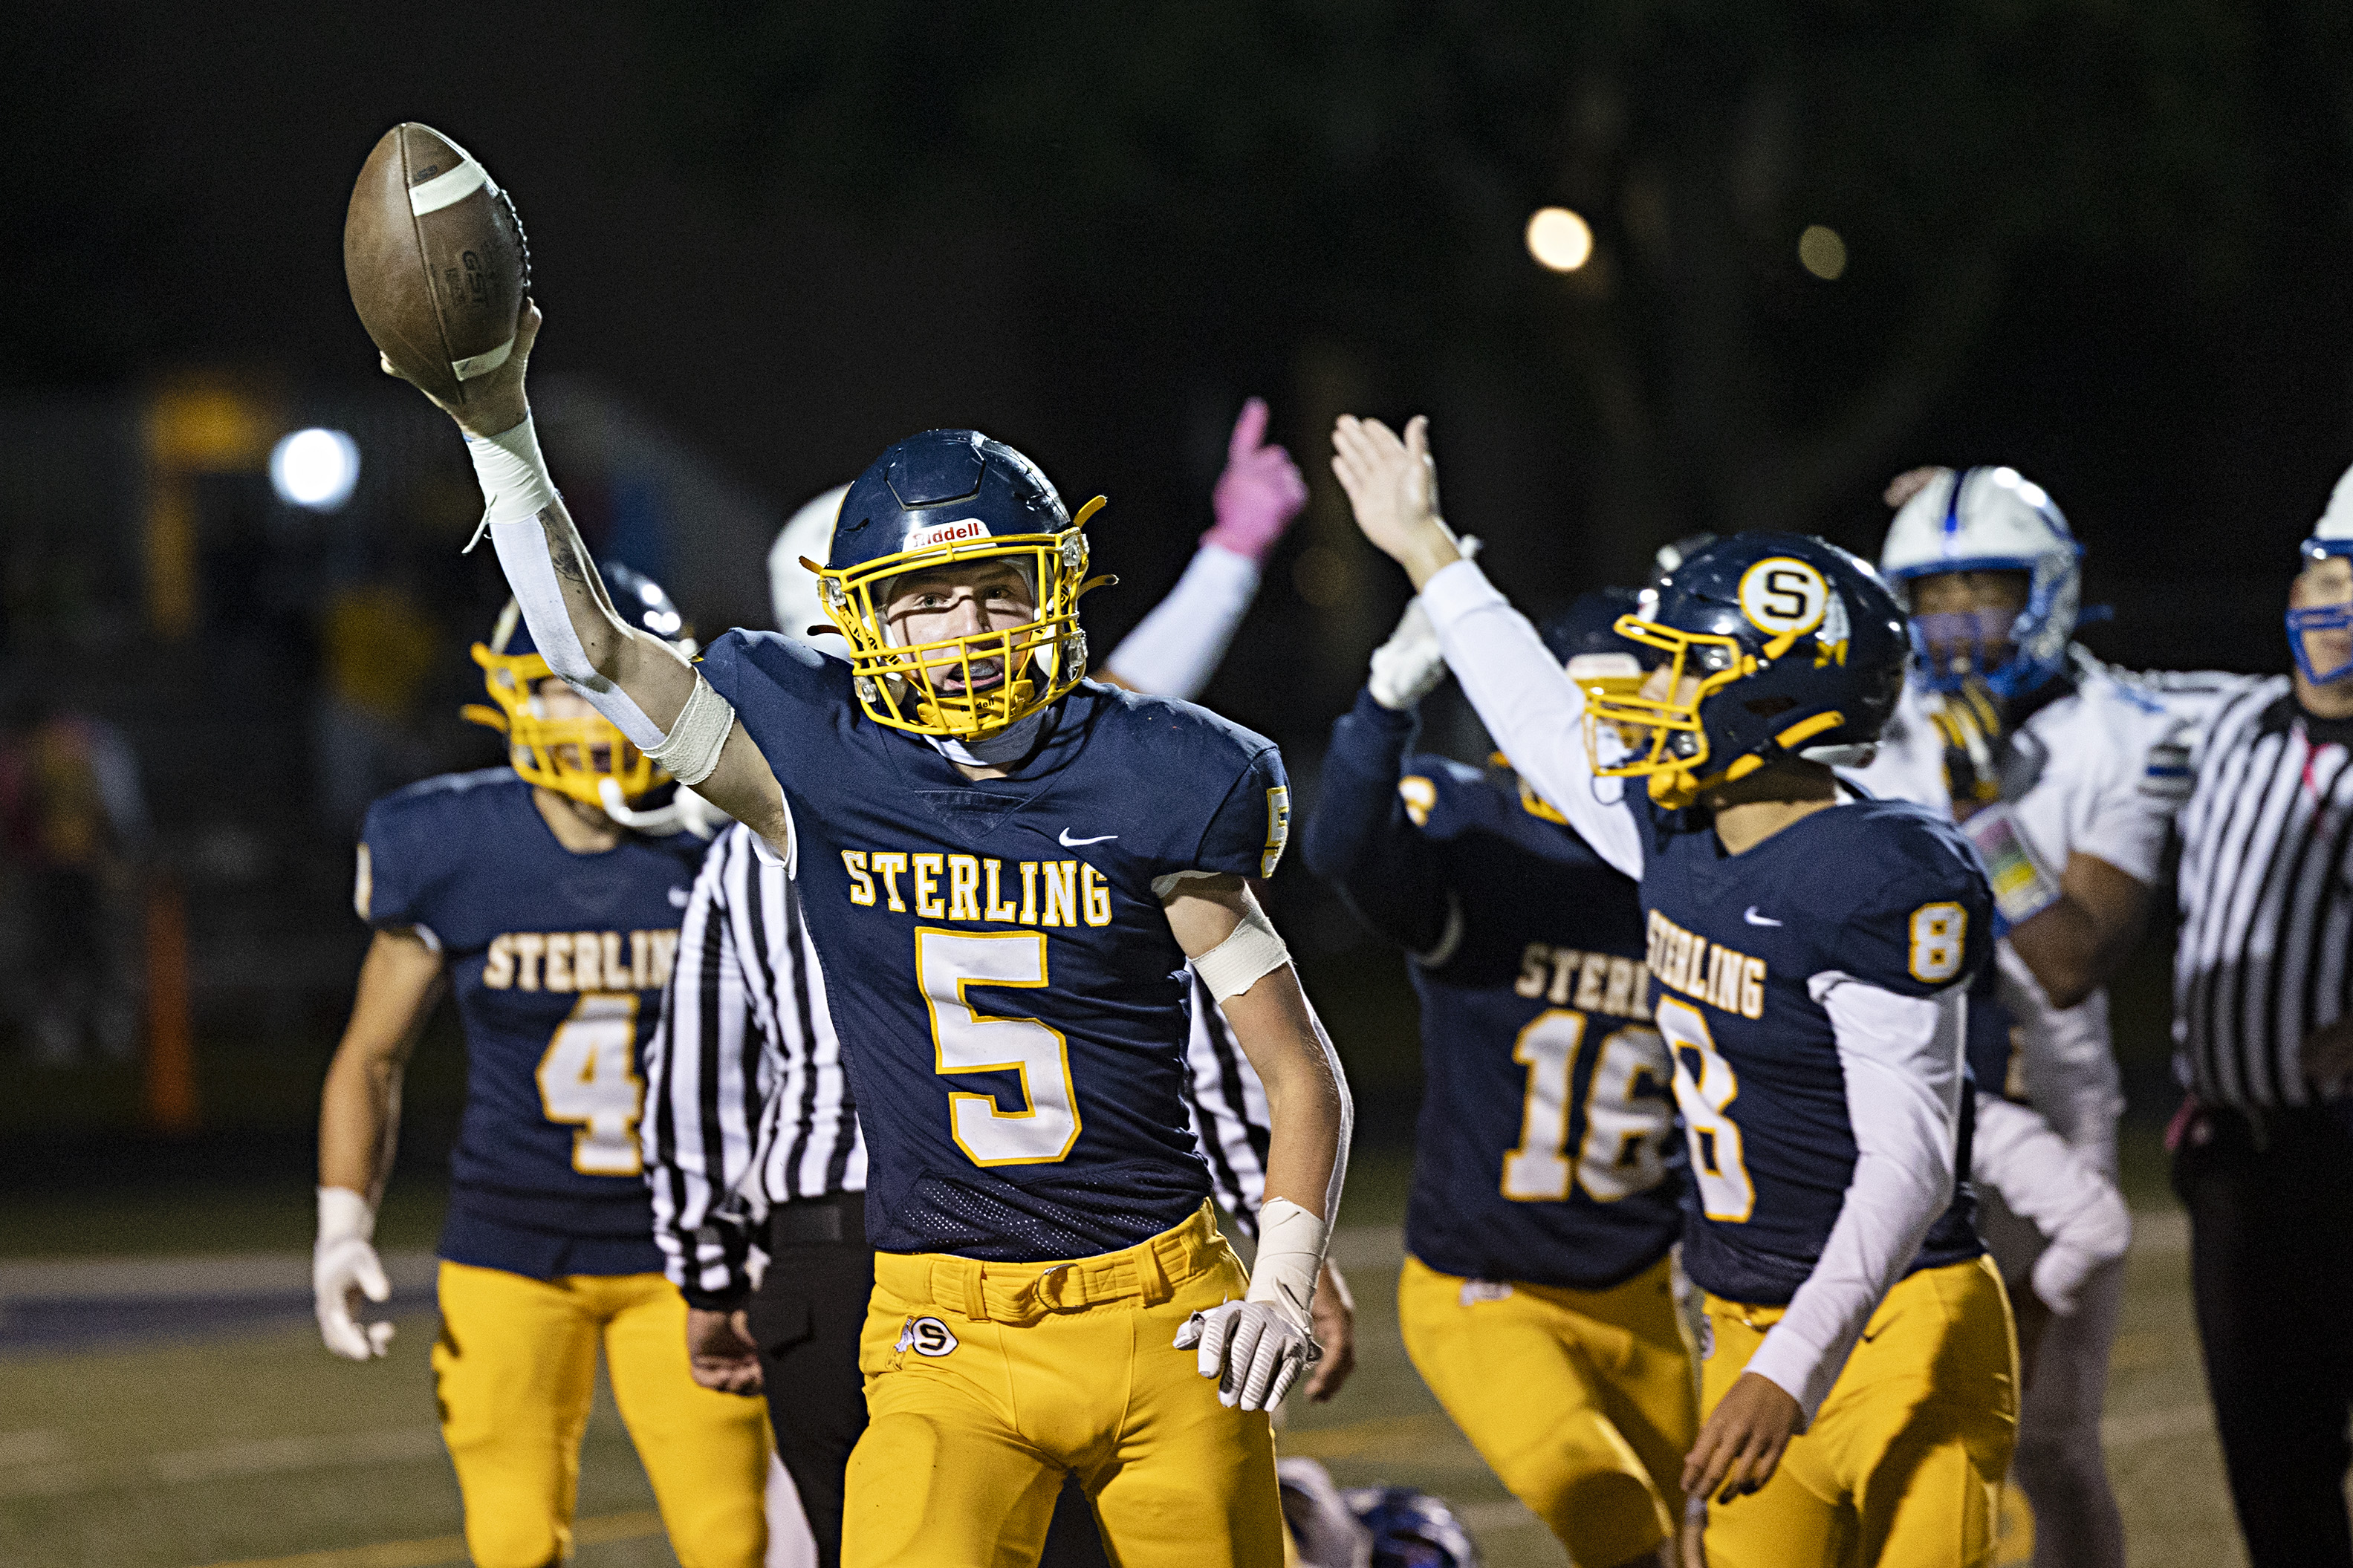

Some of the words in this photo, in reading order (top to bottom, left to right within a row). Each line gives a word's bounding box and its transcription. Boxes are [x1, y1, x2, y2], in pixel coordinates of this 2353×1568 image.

[912, 522, 979, 547] Riddell
[1763, 570, 1808, 619] S
[841, 849, 1112, 928] STERLING
[483, 930, 679, 992] STERLIN
[1514, 942, 1654, 1021] STERL
[1645, 908, 1767, 1020] STERLING
[1908, 900, 1969, 983] 8
[535, 989, 645, 1176] 4
[915, 925, 1082, 1168] 5
[1499, 1007, 1675, 1203] 16
[1655, 993, 1756, 1223] 8
[919, 1323, 947, 1350] S
